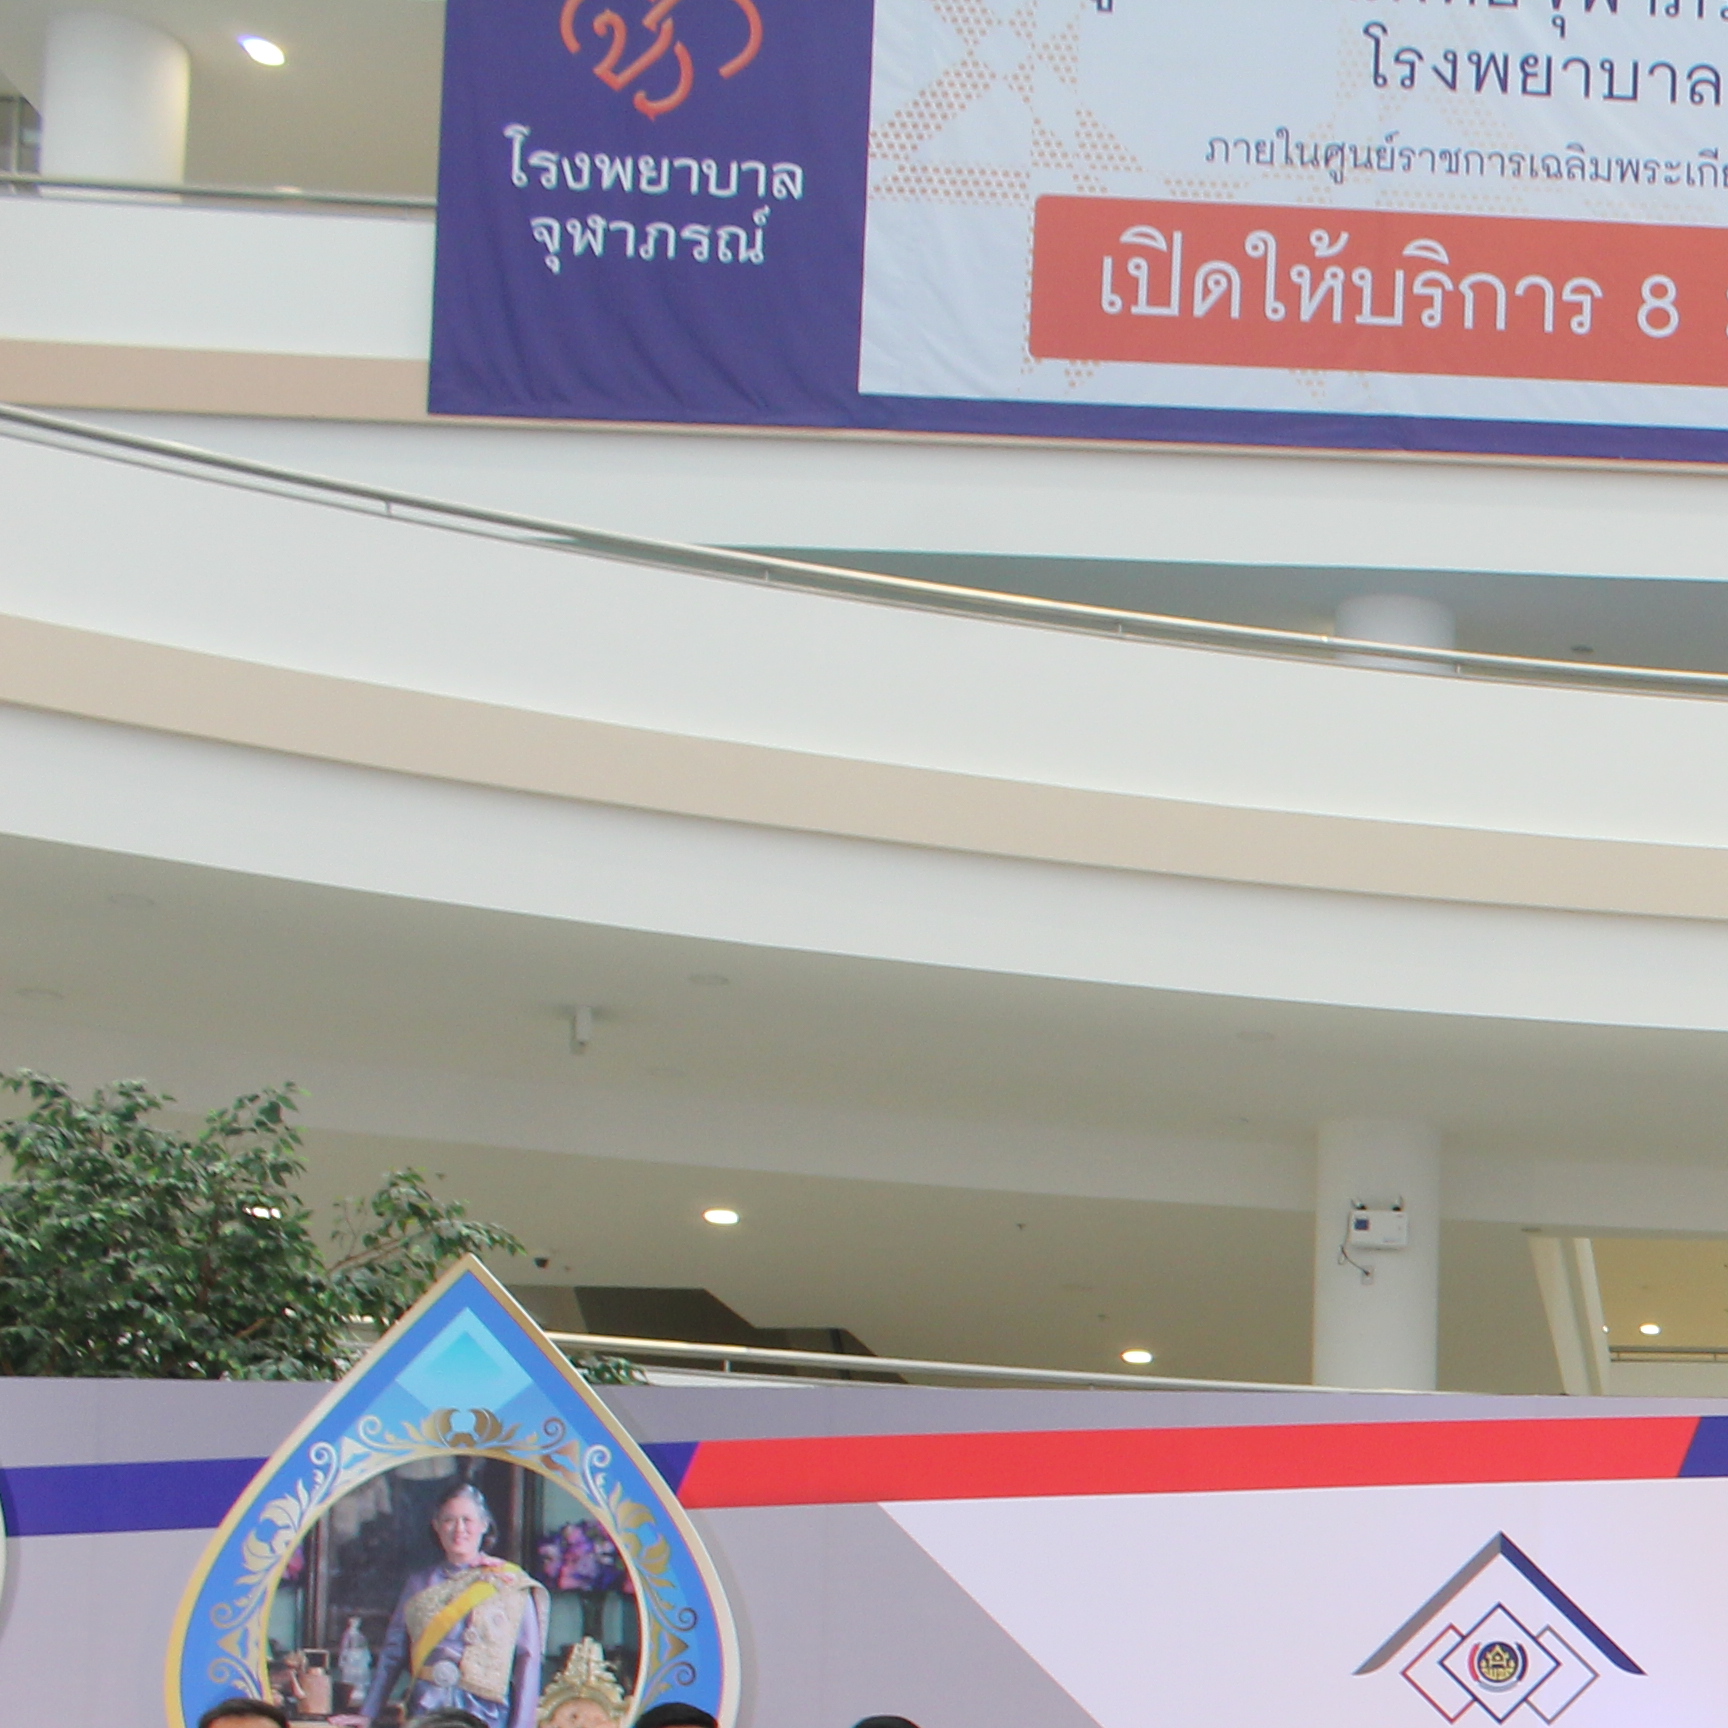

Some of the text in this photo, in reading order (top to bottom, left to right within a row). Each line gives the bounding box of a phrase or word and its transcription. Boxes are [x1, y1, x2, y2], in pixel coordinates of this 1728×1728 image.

[503, 123, 803, 200] โรงพยาบาล
[529, 205, 772, 275] จุฬาภรณ์
[1100, 224, 1603, 335] เปิดให้บริการ
[1636, 274, 1679, 338] 8
